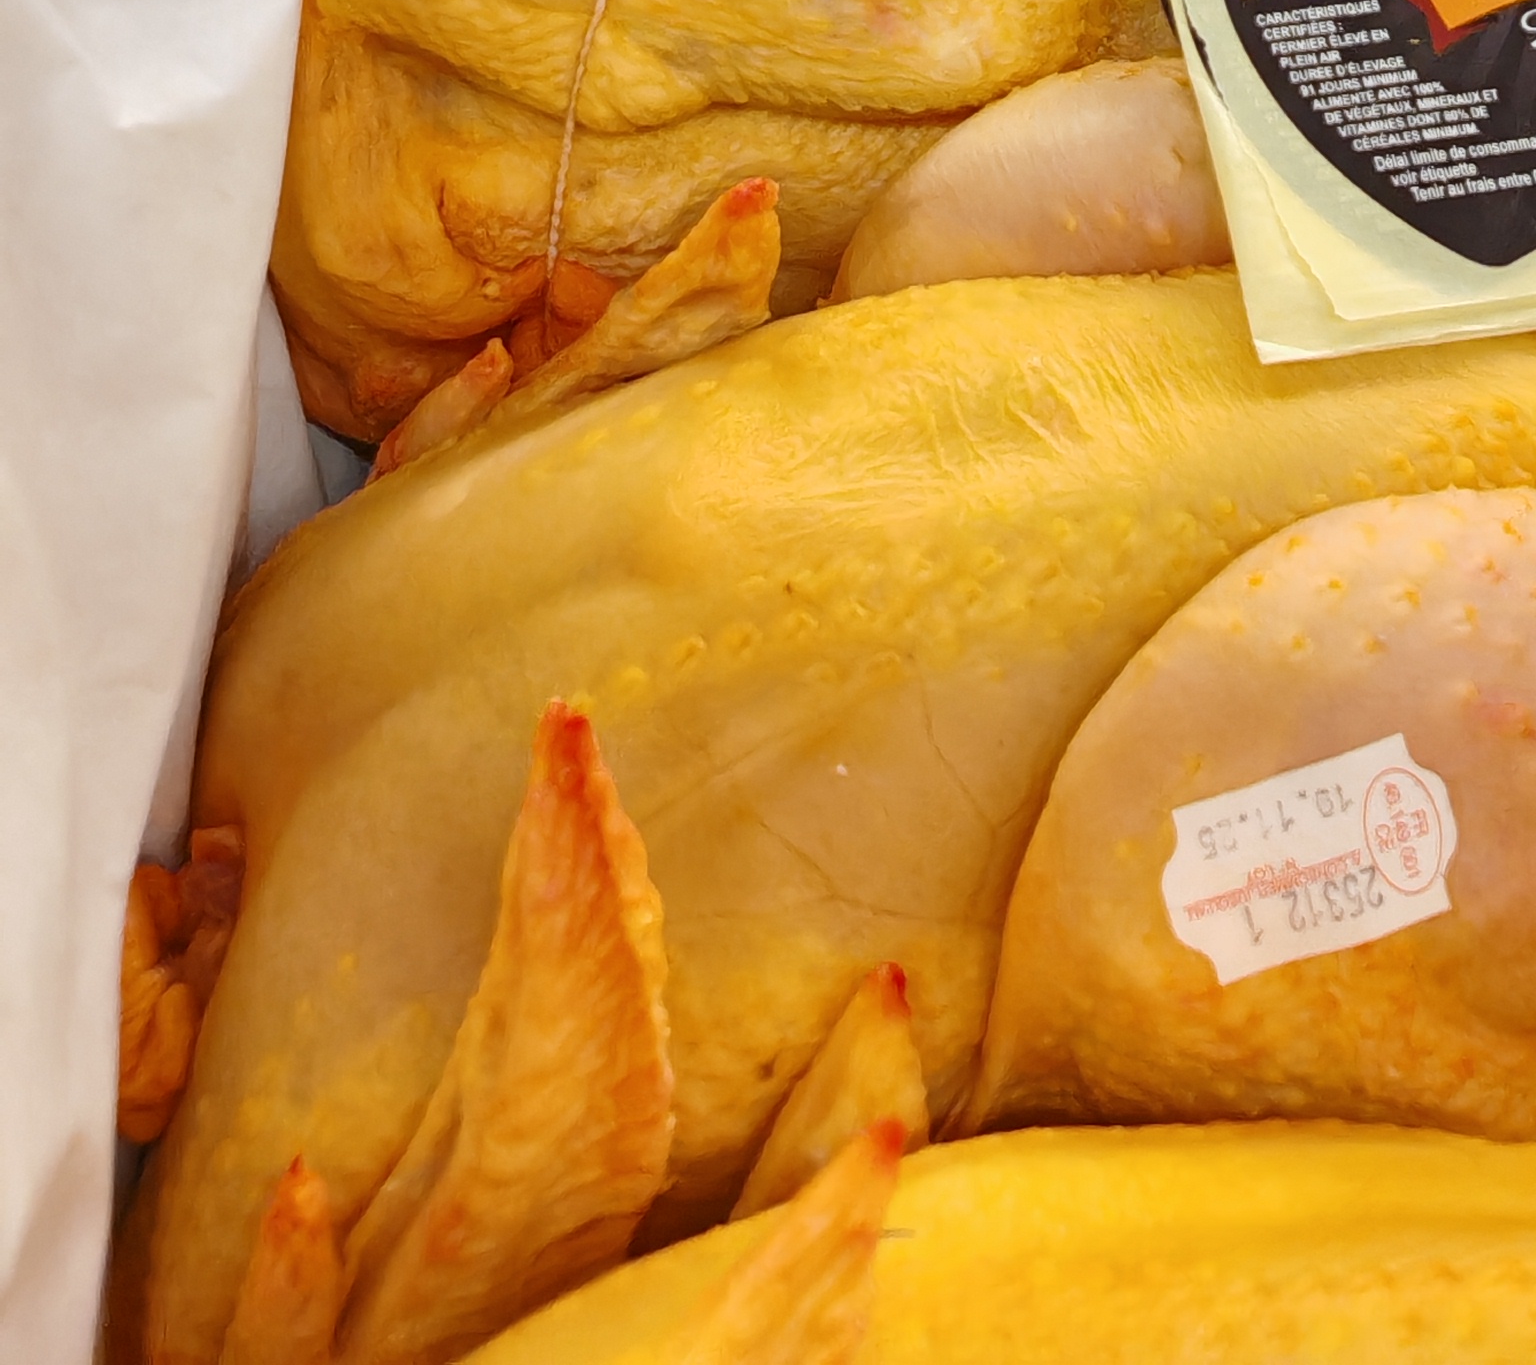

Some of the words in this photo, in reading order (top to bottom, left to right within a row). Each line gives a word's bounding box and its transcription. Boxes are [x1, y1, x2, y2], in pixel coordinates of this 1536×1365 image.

[1255, 0, 1381, 27] CARACTÉRISTIQUES
[1263, 20, 1336, 40] CERTIFIÉES
[1271, 36, 1327, 55] FERMIER
[1371, 27, 1391, 41] EN
[1279, 52, 1317, 68] PLEIN
[1320, 49, 1342, 64] AIR
[1318, 78, 1361, 94] JOURS
[1362, 69, 1419, 87] MINIMUM
[1378, 85, 1411, 101] AVEC
[1413, 81, 1446, 96] 100%
[1324, 111, 1343, 124] DE
[1482, 88, 1499, 102] ET
[1337, 117, 1405, 137] VITAMINES
[1407, 110, 1442, 127] DONT
[1470, 105, 1489, 119] DE
[1353, 130, 1421, 151] CÉRÉALES
[1374, 153, 1410, 171] Délai
[1411, 147, 1447, 166] limite
[1450, 144, 1467, 159] de
[1391, 170, 1417, 187] voir
[1420, 162, 1477, 184] étiquette
[1411, 181, 1445, 202] Tenir
[1448, 181, 1466, 195] au
[1467, 176, 1496, 193] frais
[1498, 172, 1532, 189] entre
